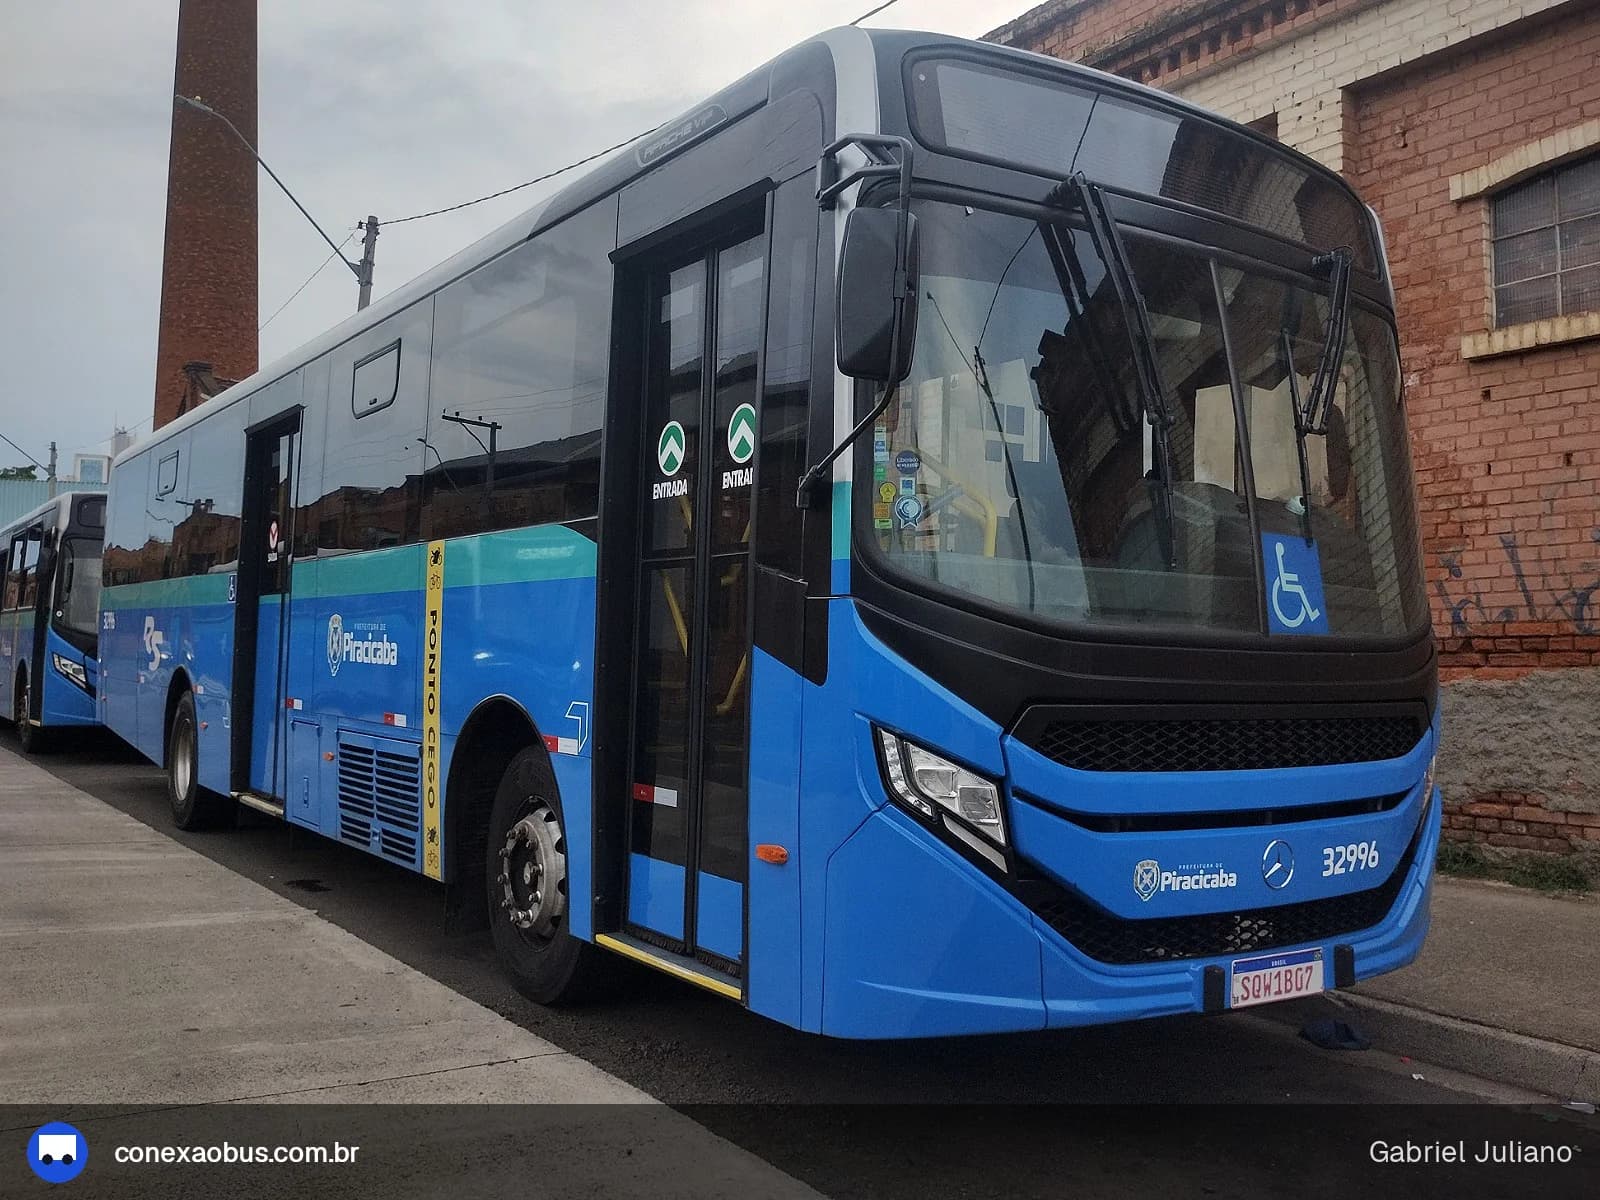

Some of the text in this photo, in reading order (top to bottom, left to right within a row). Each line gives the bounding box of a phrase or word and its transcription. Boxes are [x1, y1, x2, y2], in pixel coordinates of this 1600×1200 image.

[652, 479, 688, 500] ENTRADA
[343, 632, 398, 666] Piracicaba
[427, 609, 438, 809] PONTO CEGO
[1323, 840, 1379, 876] 32996
[1161, 869, 1237, 891] Piracicaba
